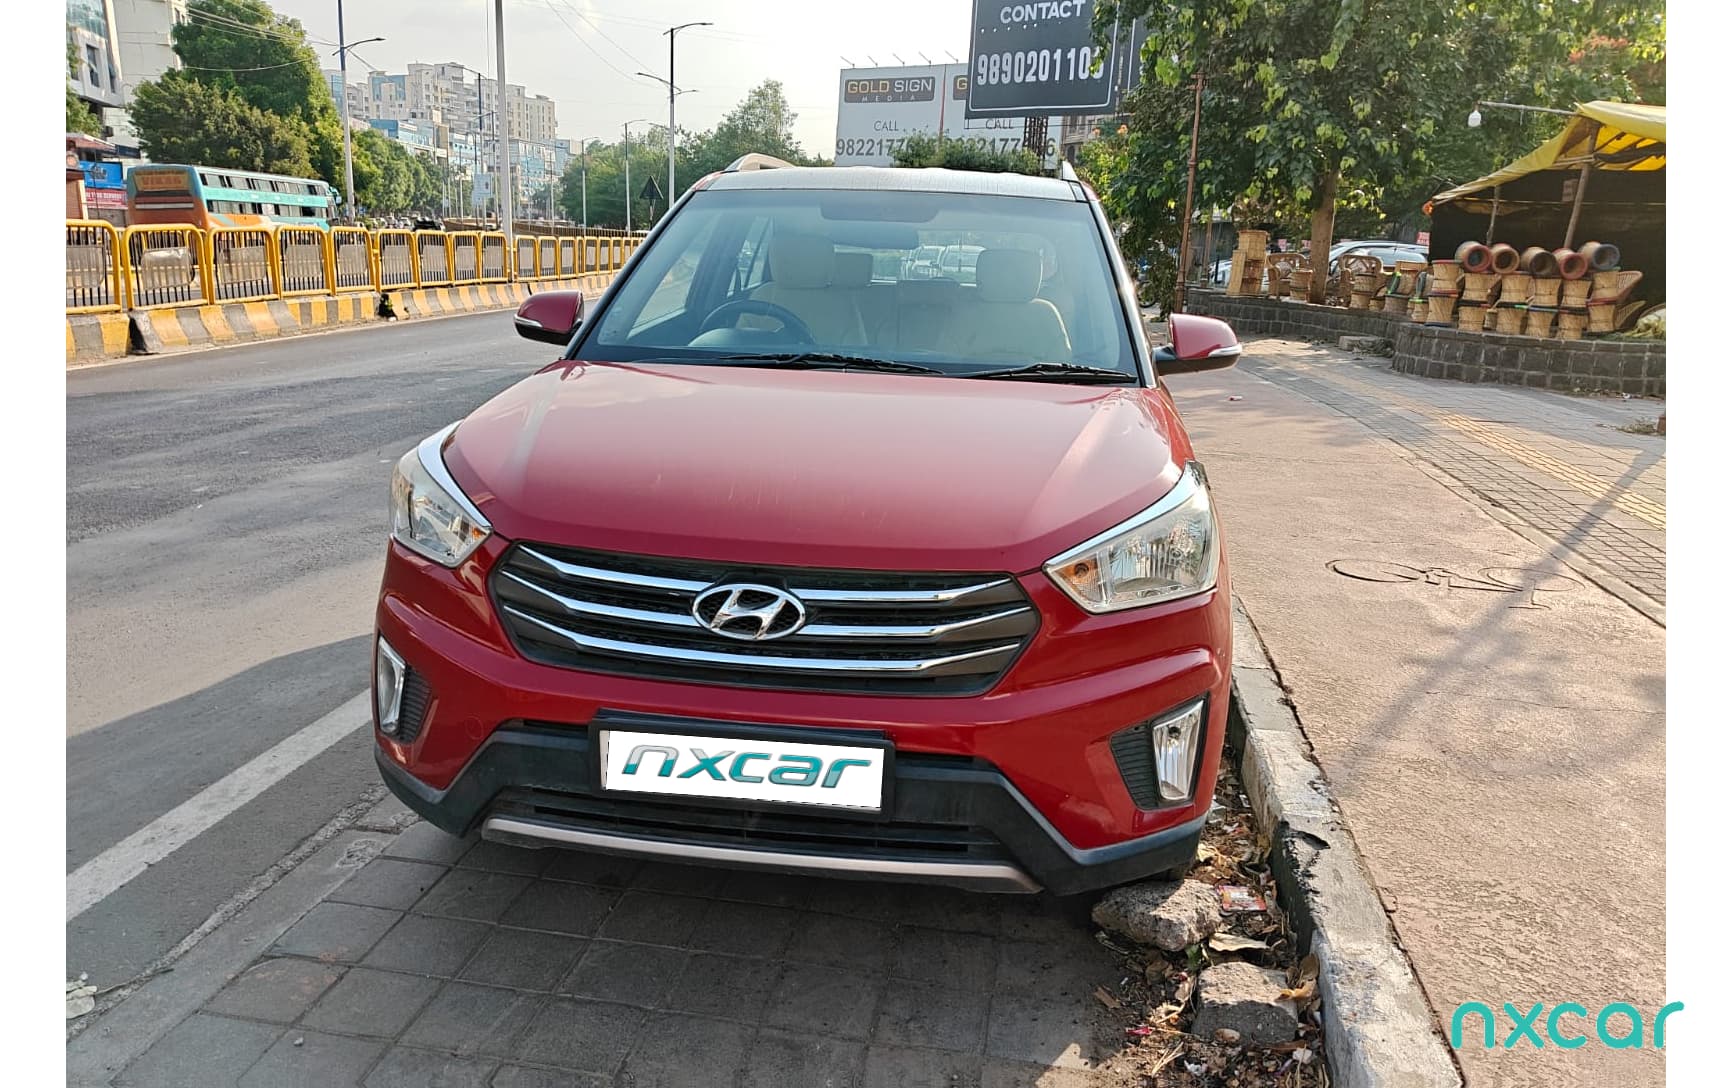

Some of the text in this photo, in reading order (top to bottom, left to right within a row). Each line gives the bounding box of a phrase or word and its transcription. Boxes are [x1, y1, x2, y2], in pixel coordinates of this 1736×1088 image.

[1000, 0, 1086, 24] CONTACT
[847, 79, 933, 94] GOLD SIGN
[873, 120, 899, 132] CALL
[985, 117, 1015, 129] CALL
